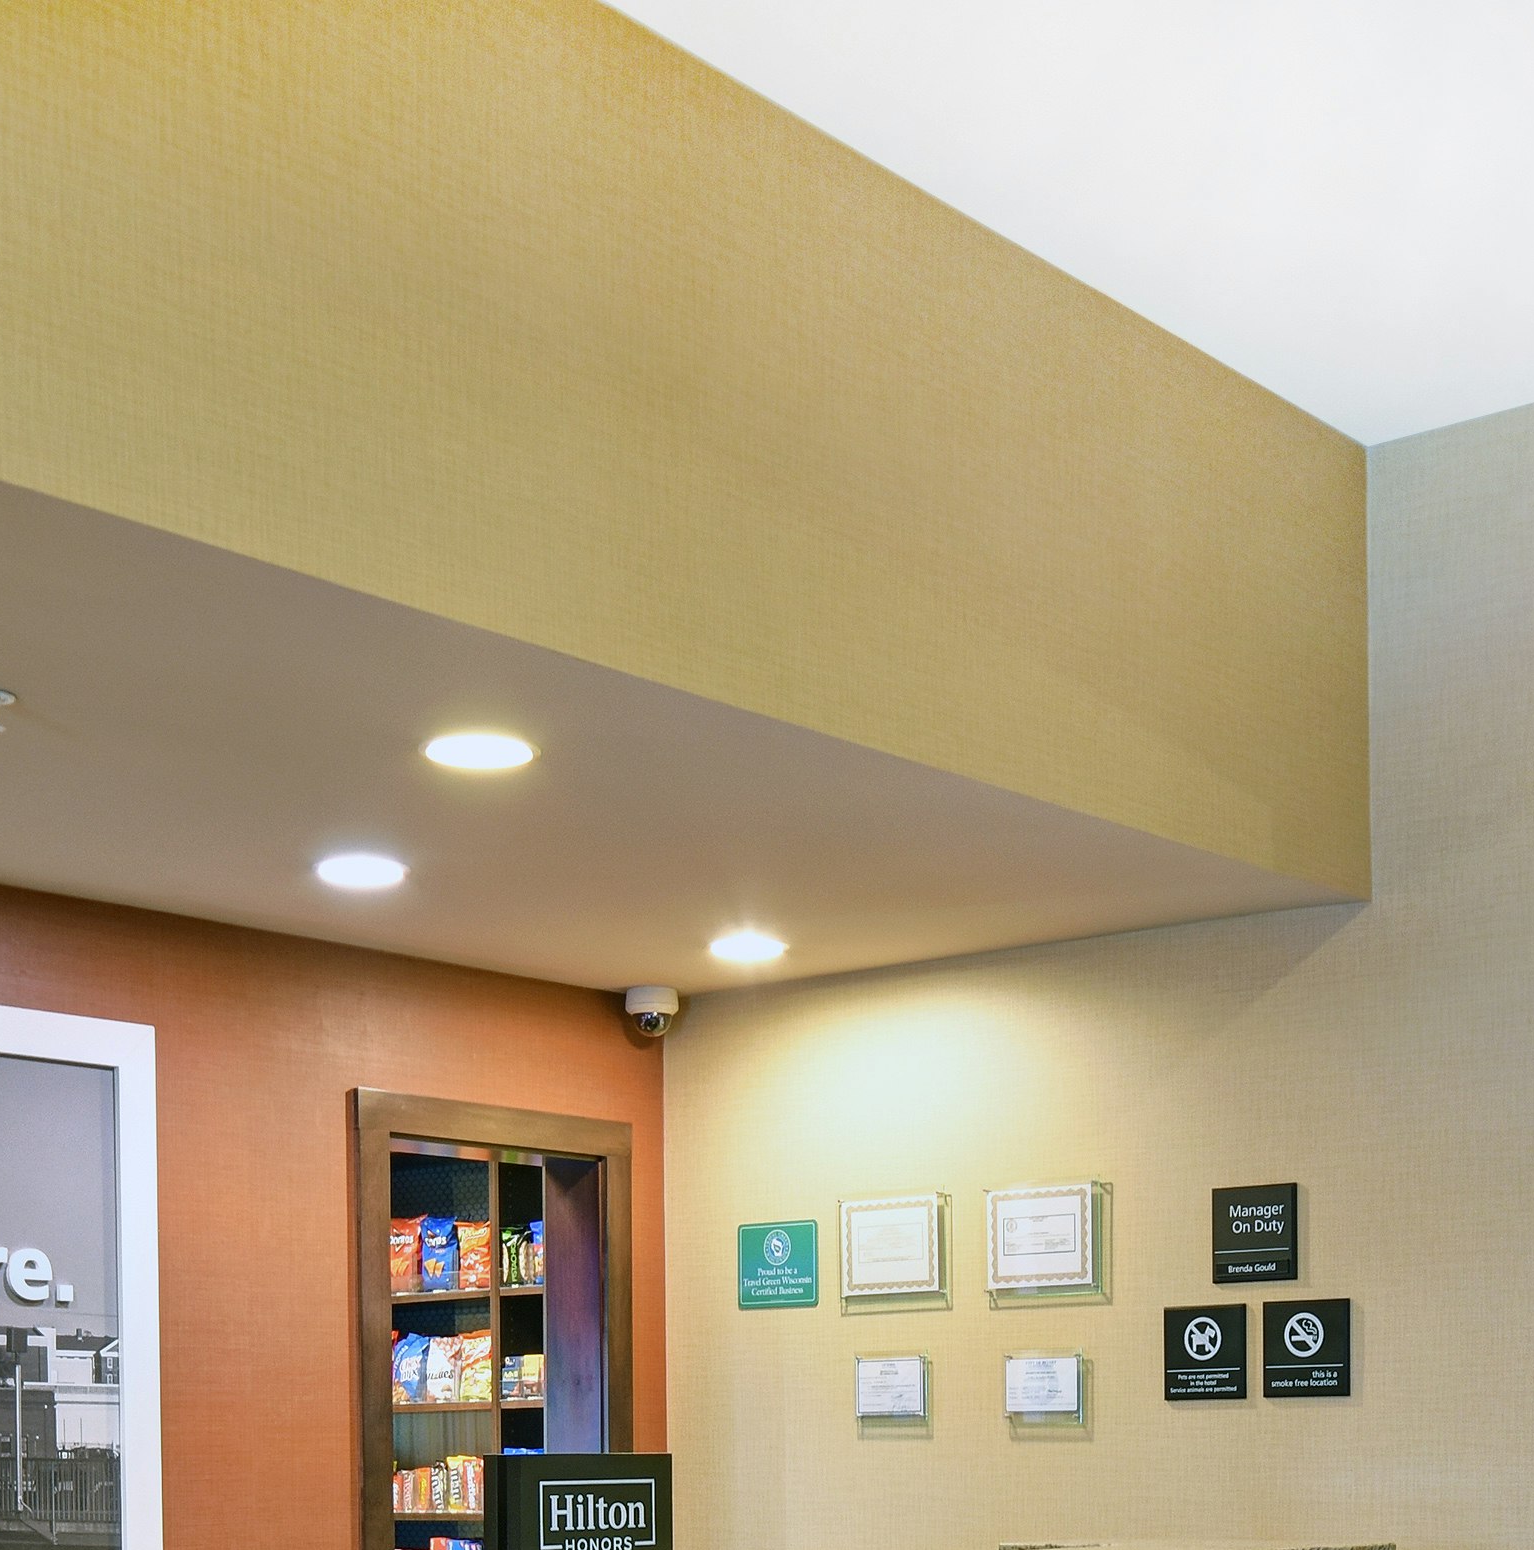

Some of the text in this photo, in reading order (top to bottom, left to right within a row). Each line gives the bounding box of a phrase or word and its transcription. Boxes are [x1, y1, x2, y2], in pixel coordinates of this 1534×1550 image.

[1229, 1204, 1284, 1219] Manager
[1232, 1220, 1284, 1234] On Duty
[758, 1267, 775, 1276] Proud
[785, 1266, 793, 1275] be
[1228, 1262, 1276, 1274] Brenda Gould
[743, 1276, 812, 1287] Travel Green Wisconsin
[752, 1286, 803, 1296] Certified Business
[1312, 1370, 1325, 1378] this
[1326, 1370, 1331, 1378] is
[1272, 1379, 1293, 1387] smoke
[550, 1494, 646, 1532] Hilton
